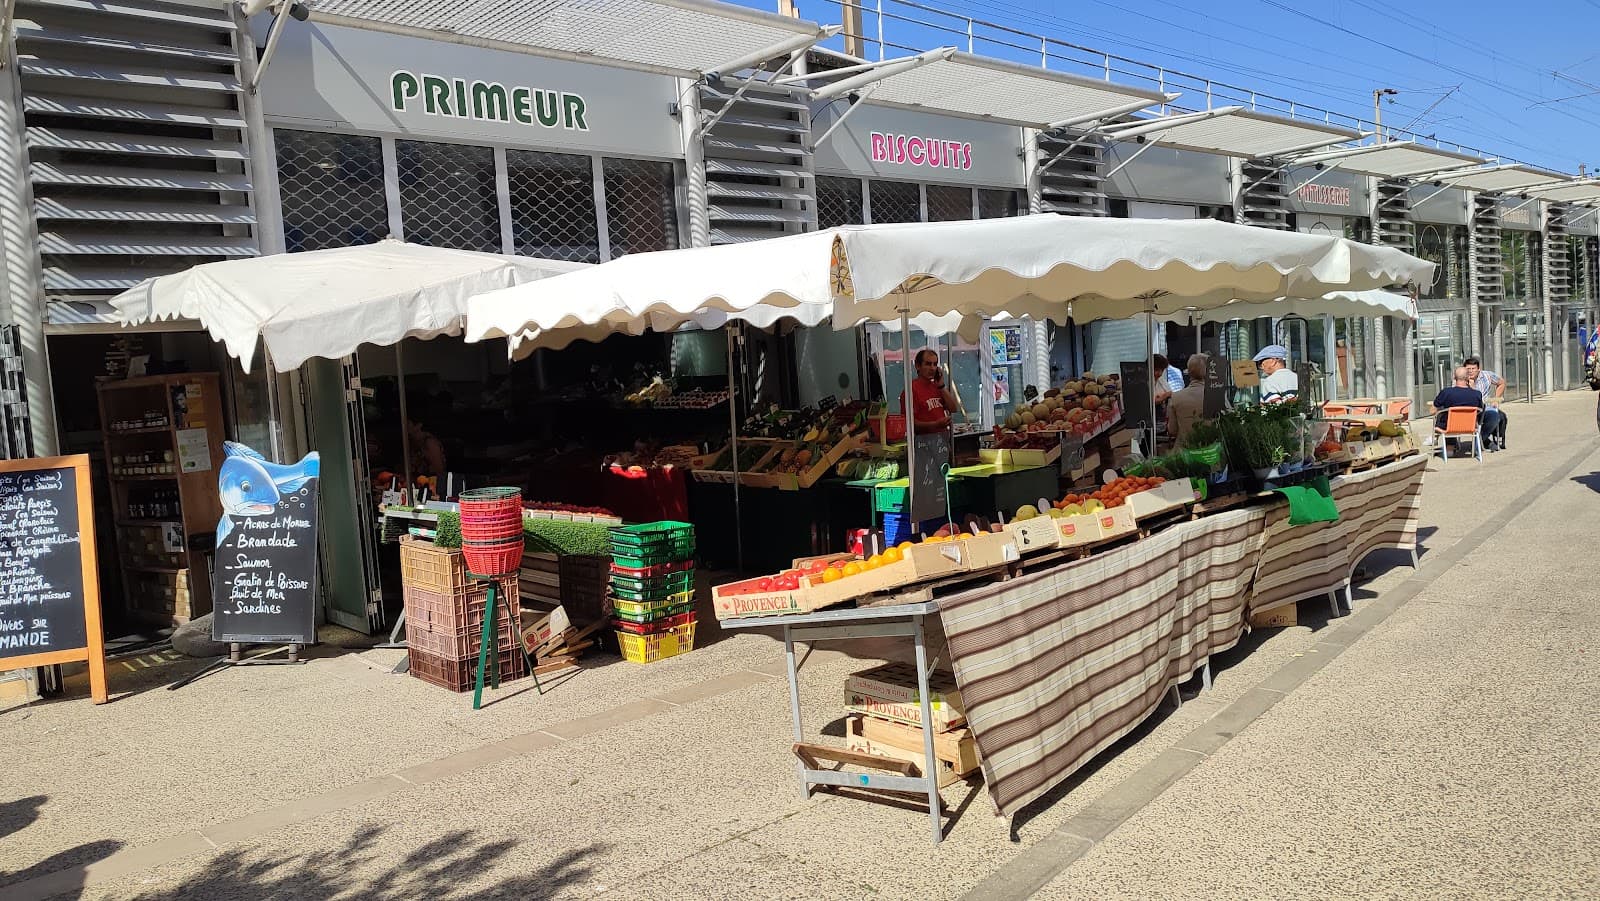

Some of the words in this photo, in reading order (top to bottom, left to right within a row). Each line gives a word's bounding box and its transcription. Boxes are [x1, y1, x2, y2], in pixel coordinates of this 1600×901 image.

[390, 70, 590, 131] PRIMEUR
[870, 131, 972, 170] BISCUITS
[270, 516, 281, 529] de
[234, 553, 273, 569] Saumon
[265, 571, 275, 587] de
[251, 587, 263, 599] de
[732, 597, 788, 616] PROVENCE
[865, 695, 921, 721] PROVENCE
